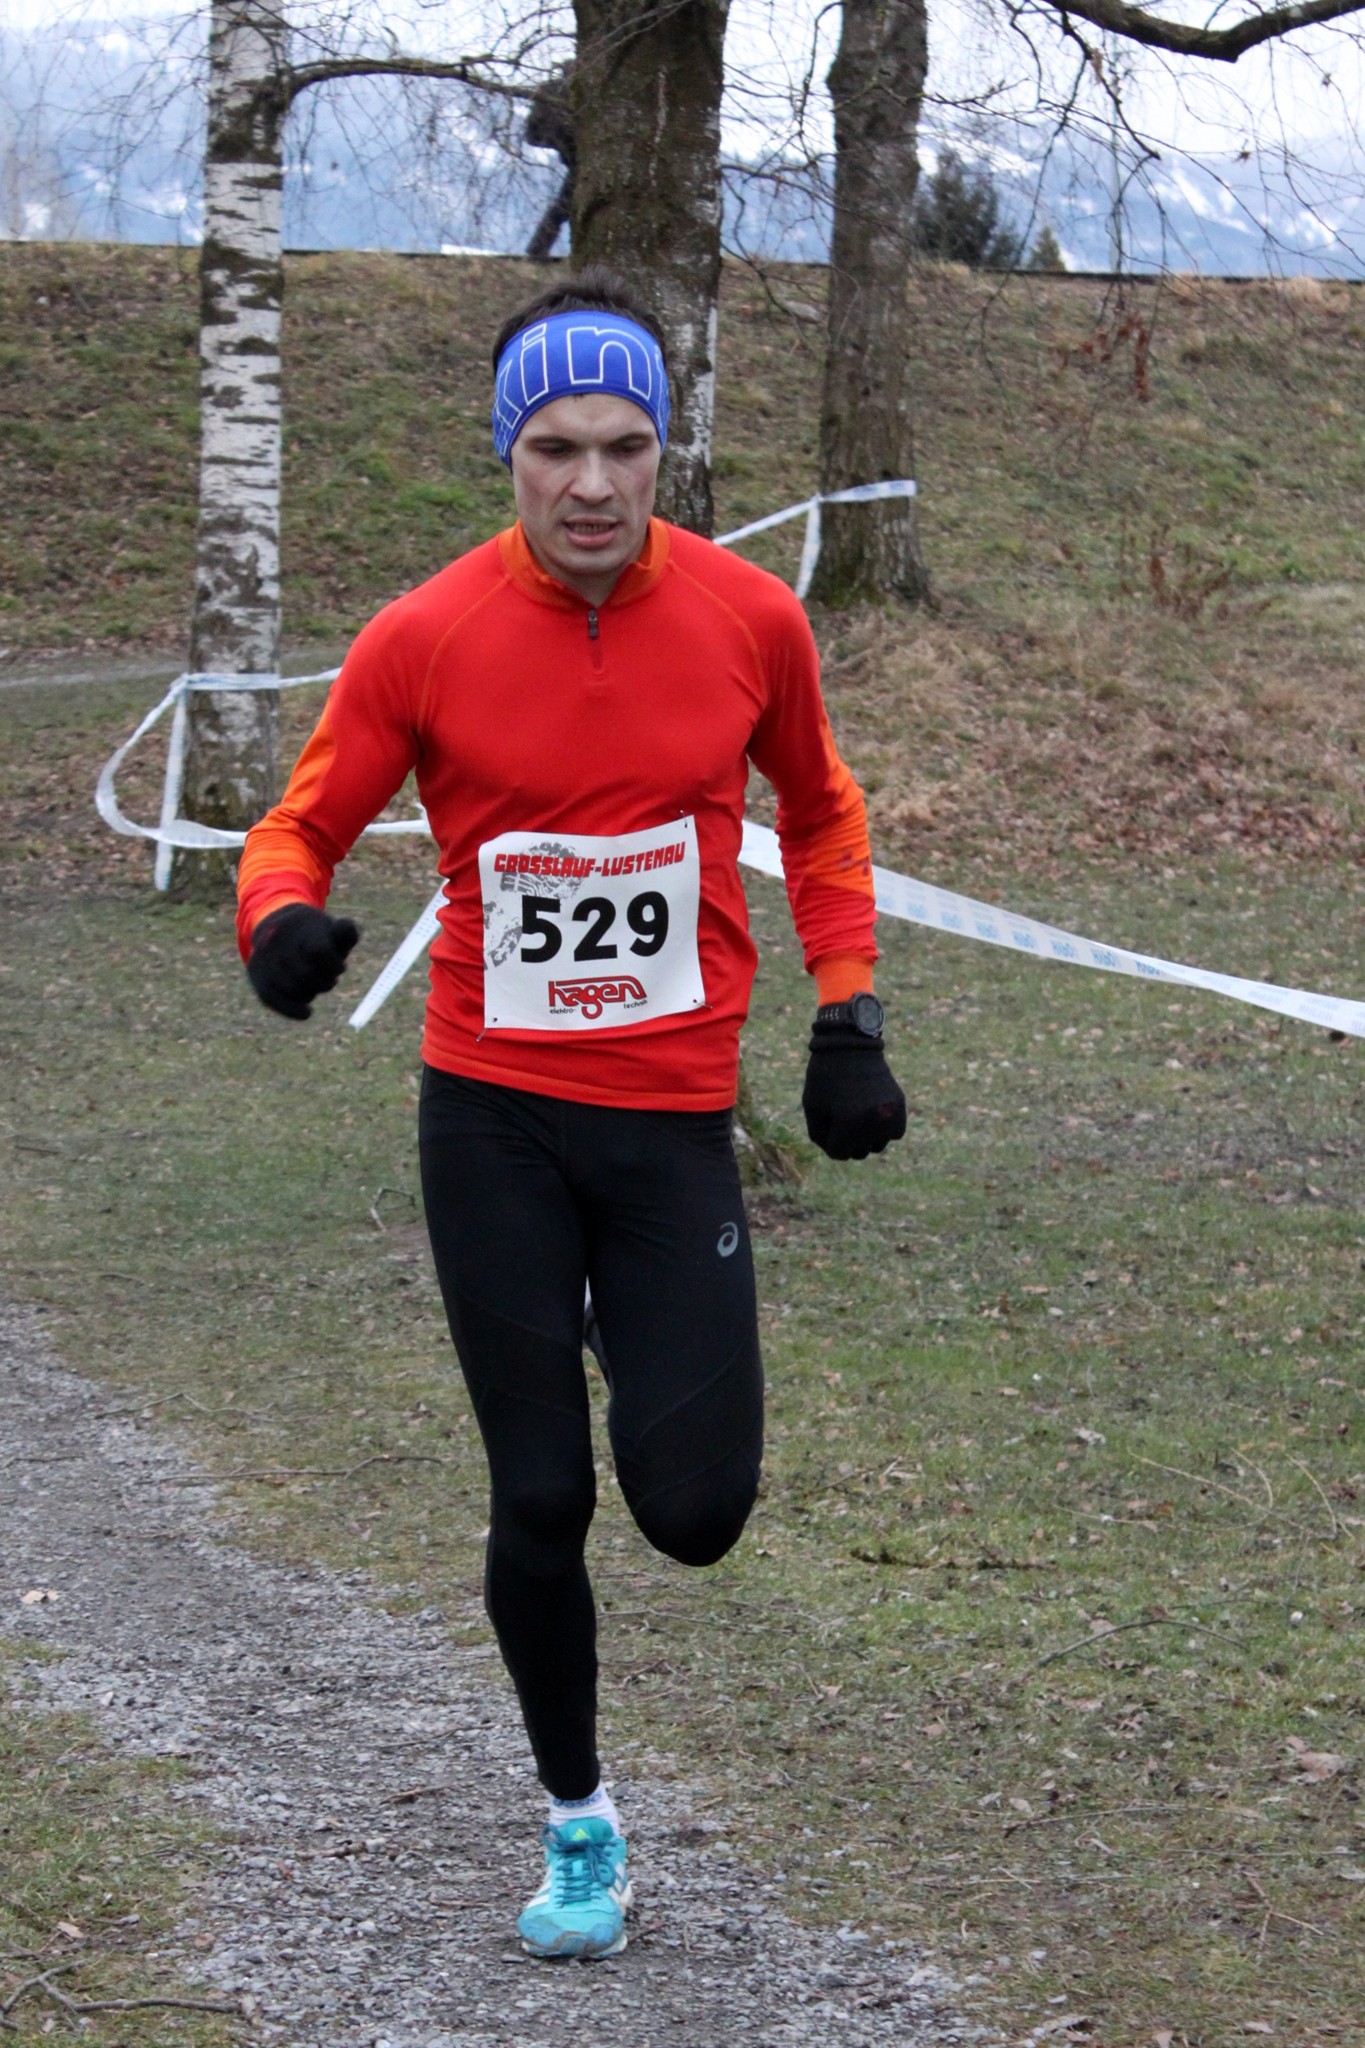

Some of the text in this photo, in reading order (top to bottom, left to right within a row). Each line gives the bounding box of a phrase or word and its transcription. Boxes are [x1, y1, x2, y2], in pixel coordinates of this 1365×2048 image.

[493, 841, 686, 878] CROSSLAUF-LUSTENAU
[520, 890, 669, 963] 529
[548, 975, 648, 1020] hagen
